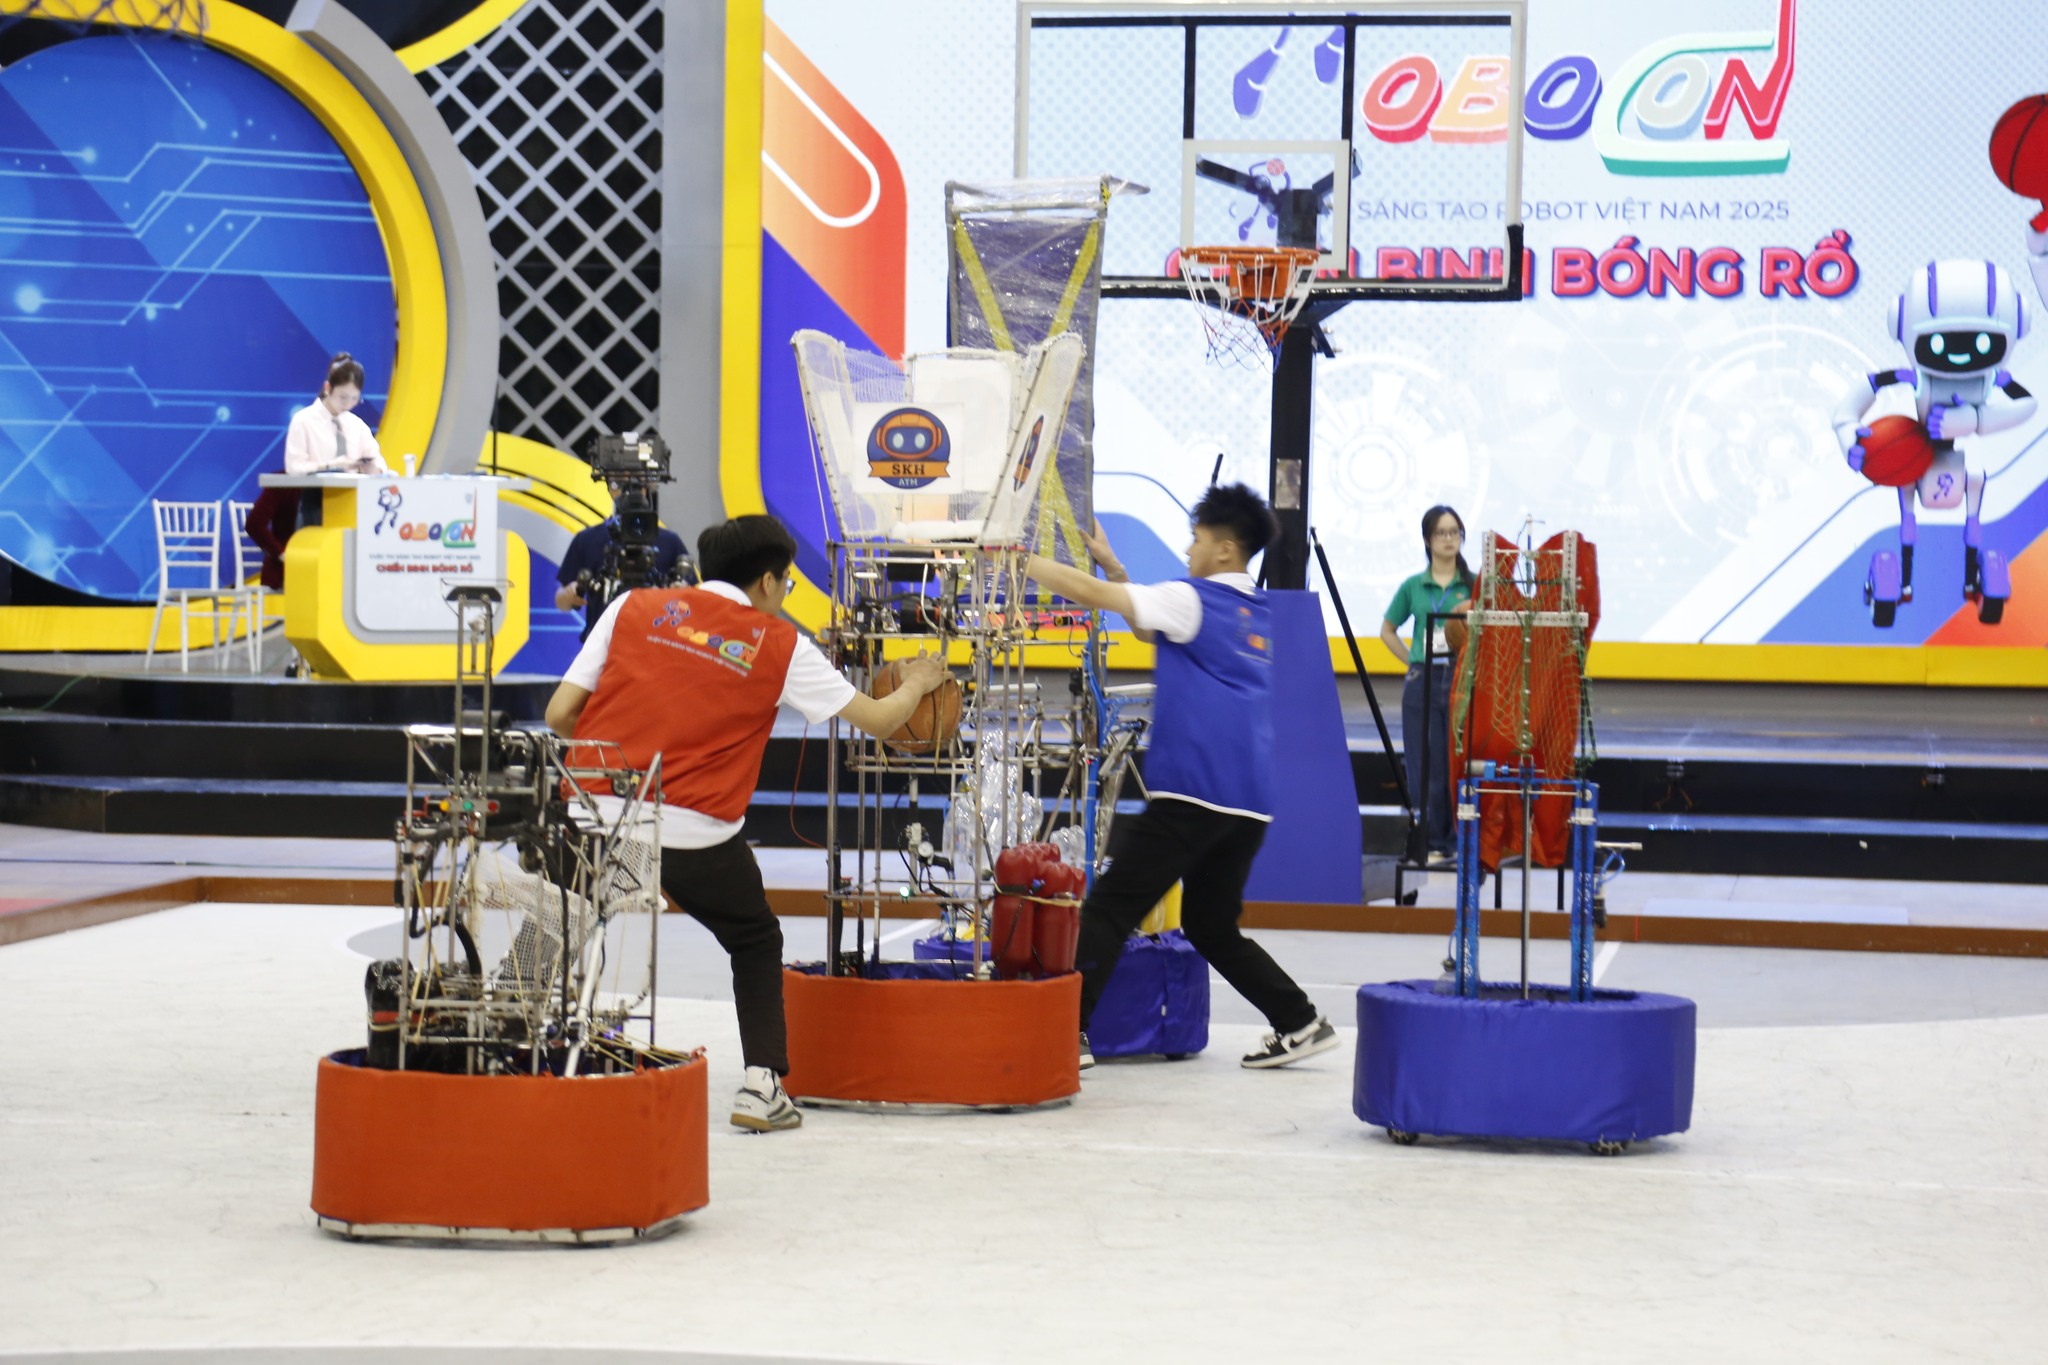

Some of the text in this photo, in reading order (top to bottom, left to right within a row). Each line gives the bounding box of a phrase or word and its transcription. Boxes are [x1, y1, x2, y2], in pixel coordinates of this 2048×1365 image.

[1357, 194, 1428, 221] SÁNG
[1593, 195, 1652, 225] VIỆT
[1660, 201, 1720, 220] NAM
[1728, 201, 1790, 220] 2025
[1550, 235, 1744, 298] BÓNG
[1759, 228, 1858, 298] RỔ
[892, 463, 926, 475] SKH
[898, 478, 919, 487] ATM
